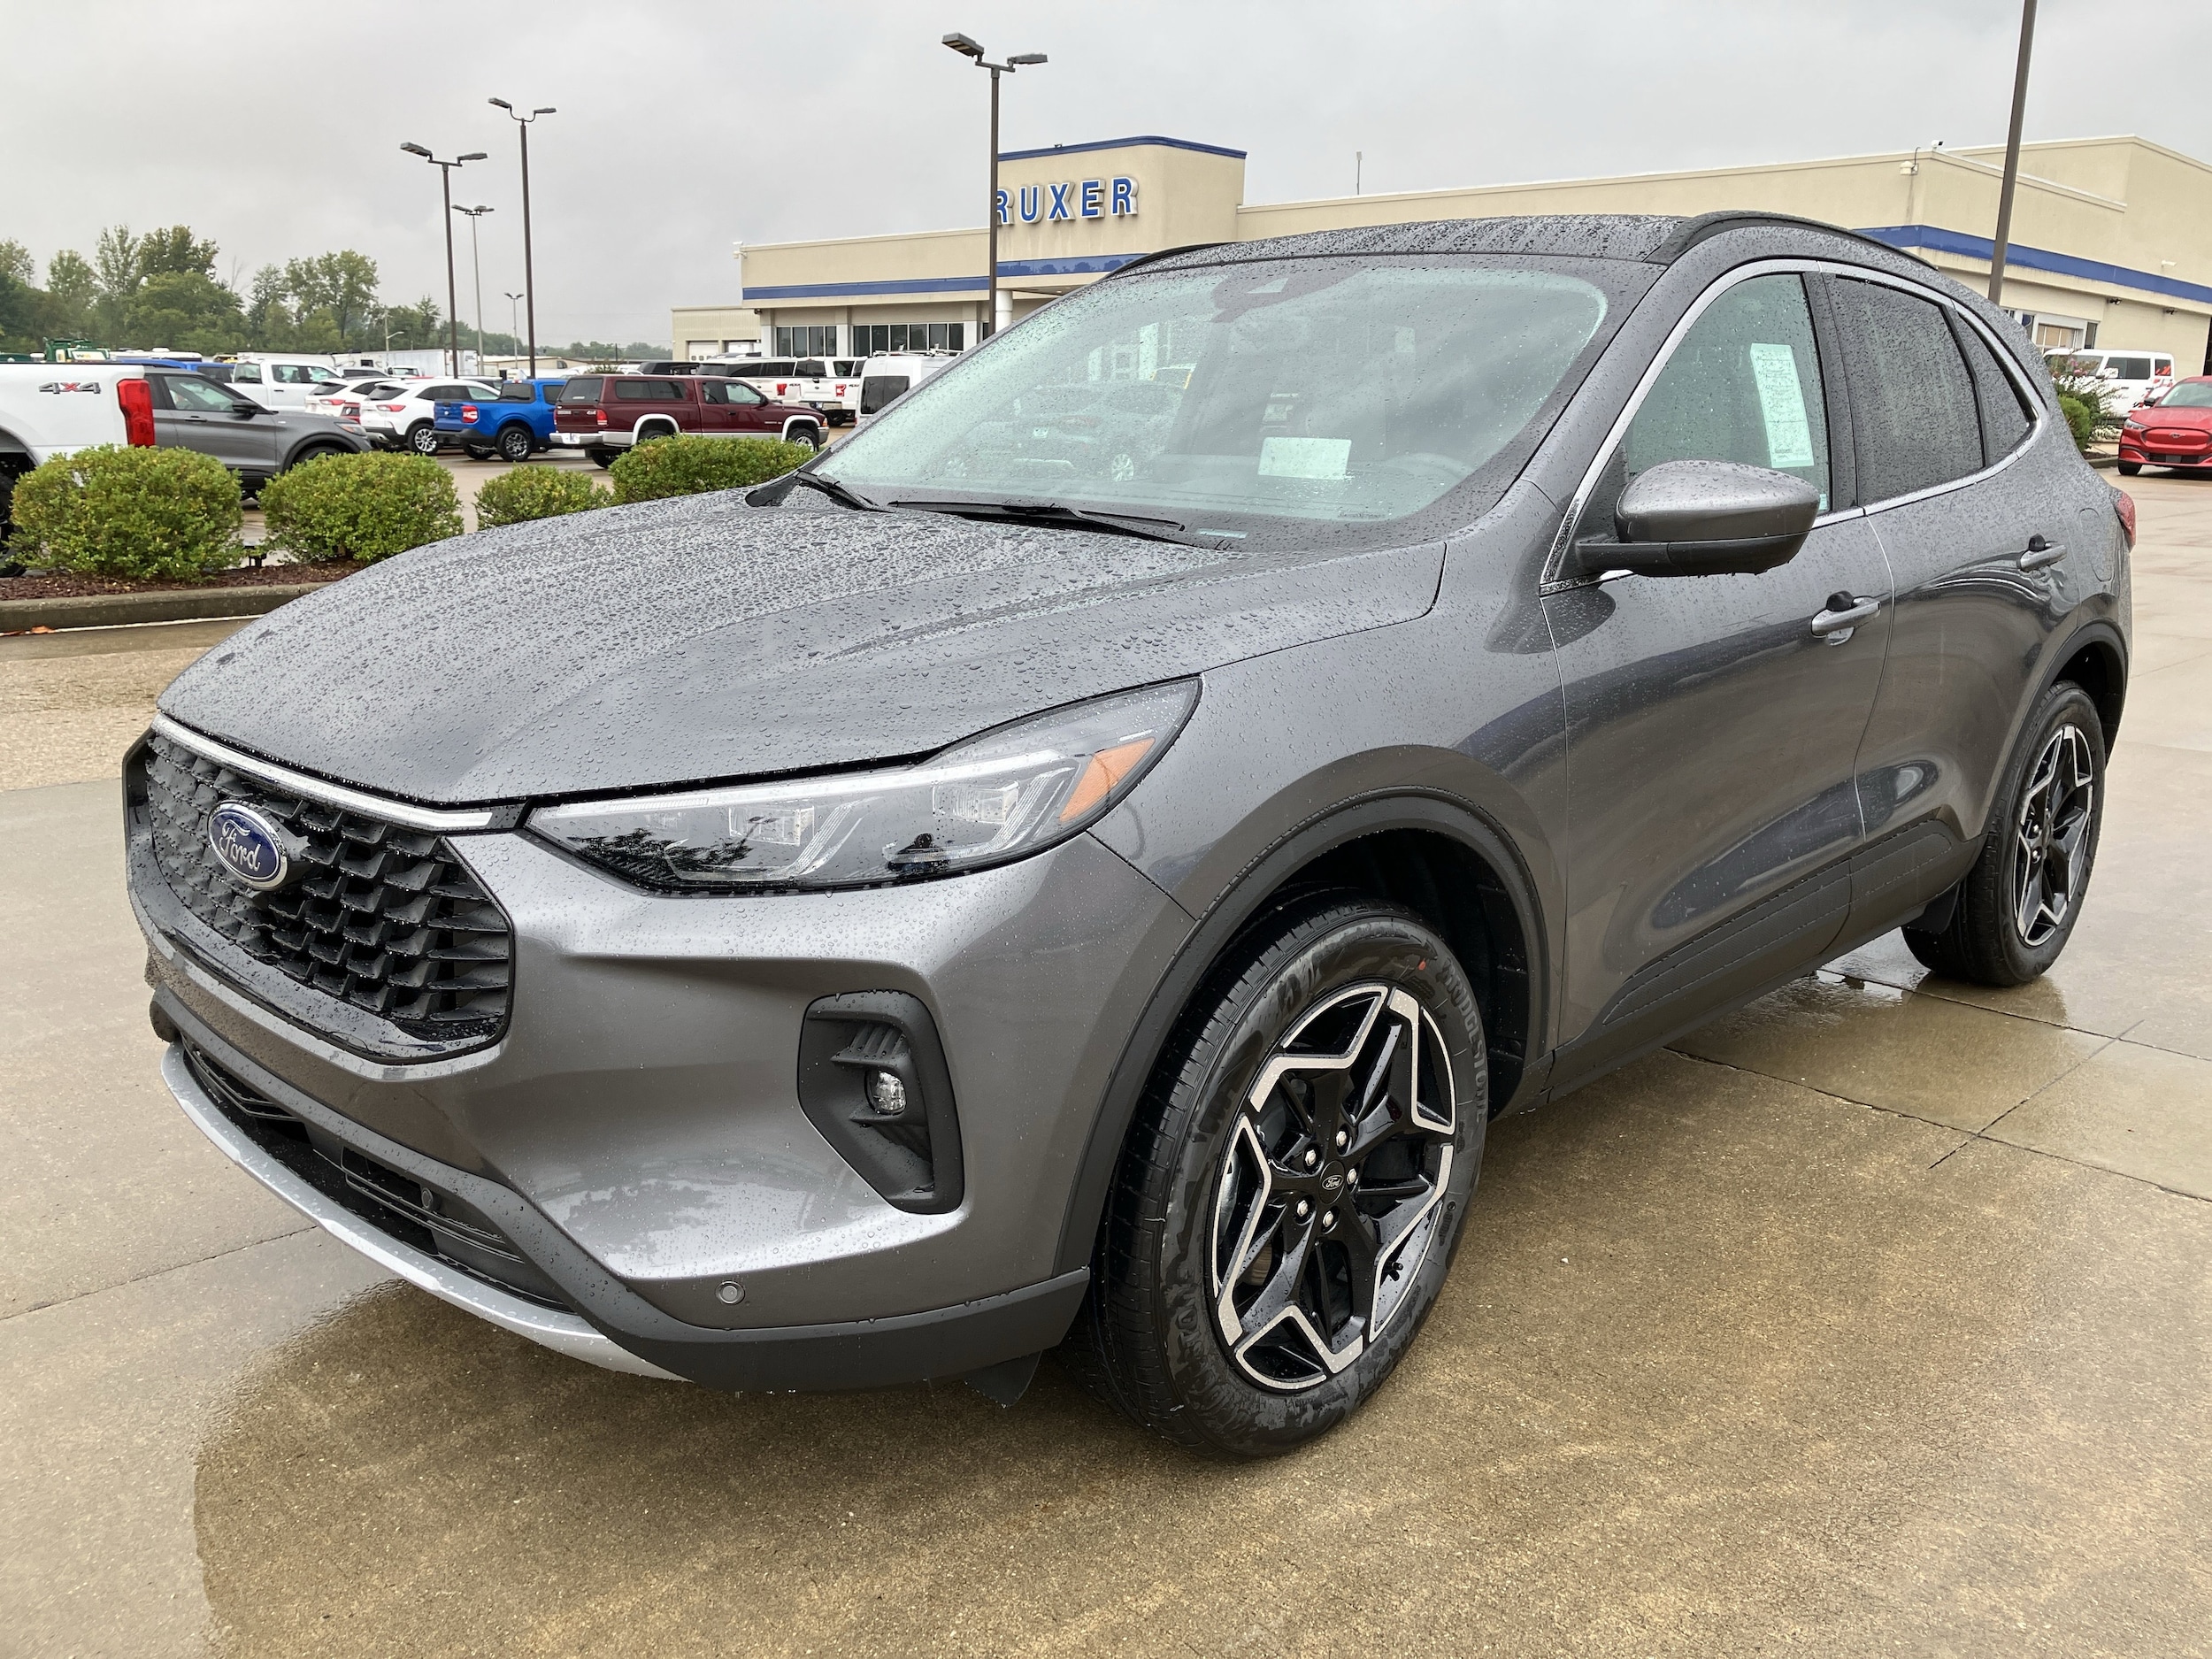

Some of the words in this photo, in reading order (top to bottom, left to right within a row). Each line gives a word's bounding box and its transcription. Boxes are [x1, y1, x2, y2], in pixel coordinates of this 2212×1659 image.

[996, 176, 1139, 225] RUXER
[219, 819, 261, 872] Ford
[1437, 957, 1487, 1124] BRIDGESTONE
[1325, 1177, 1341, 1187] Ford
